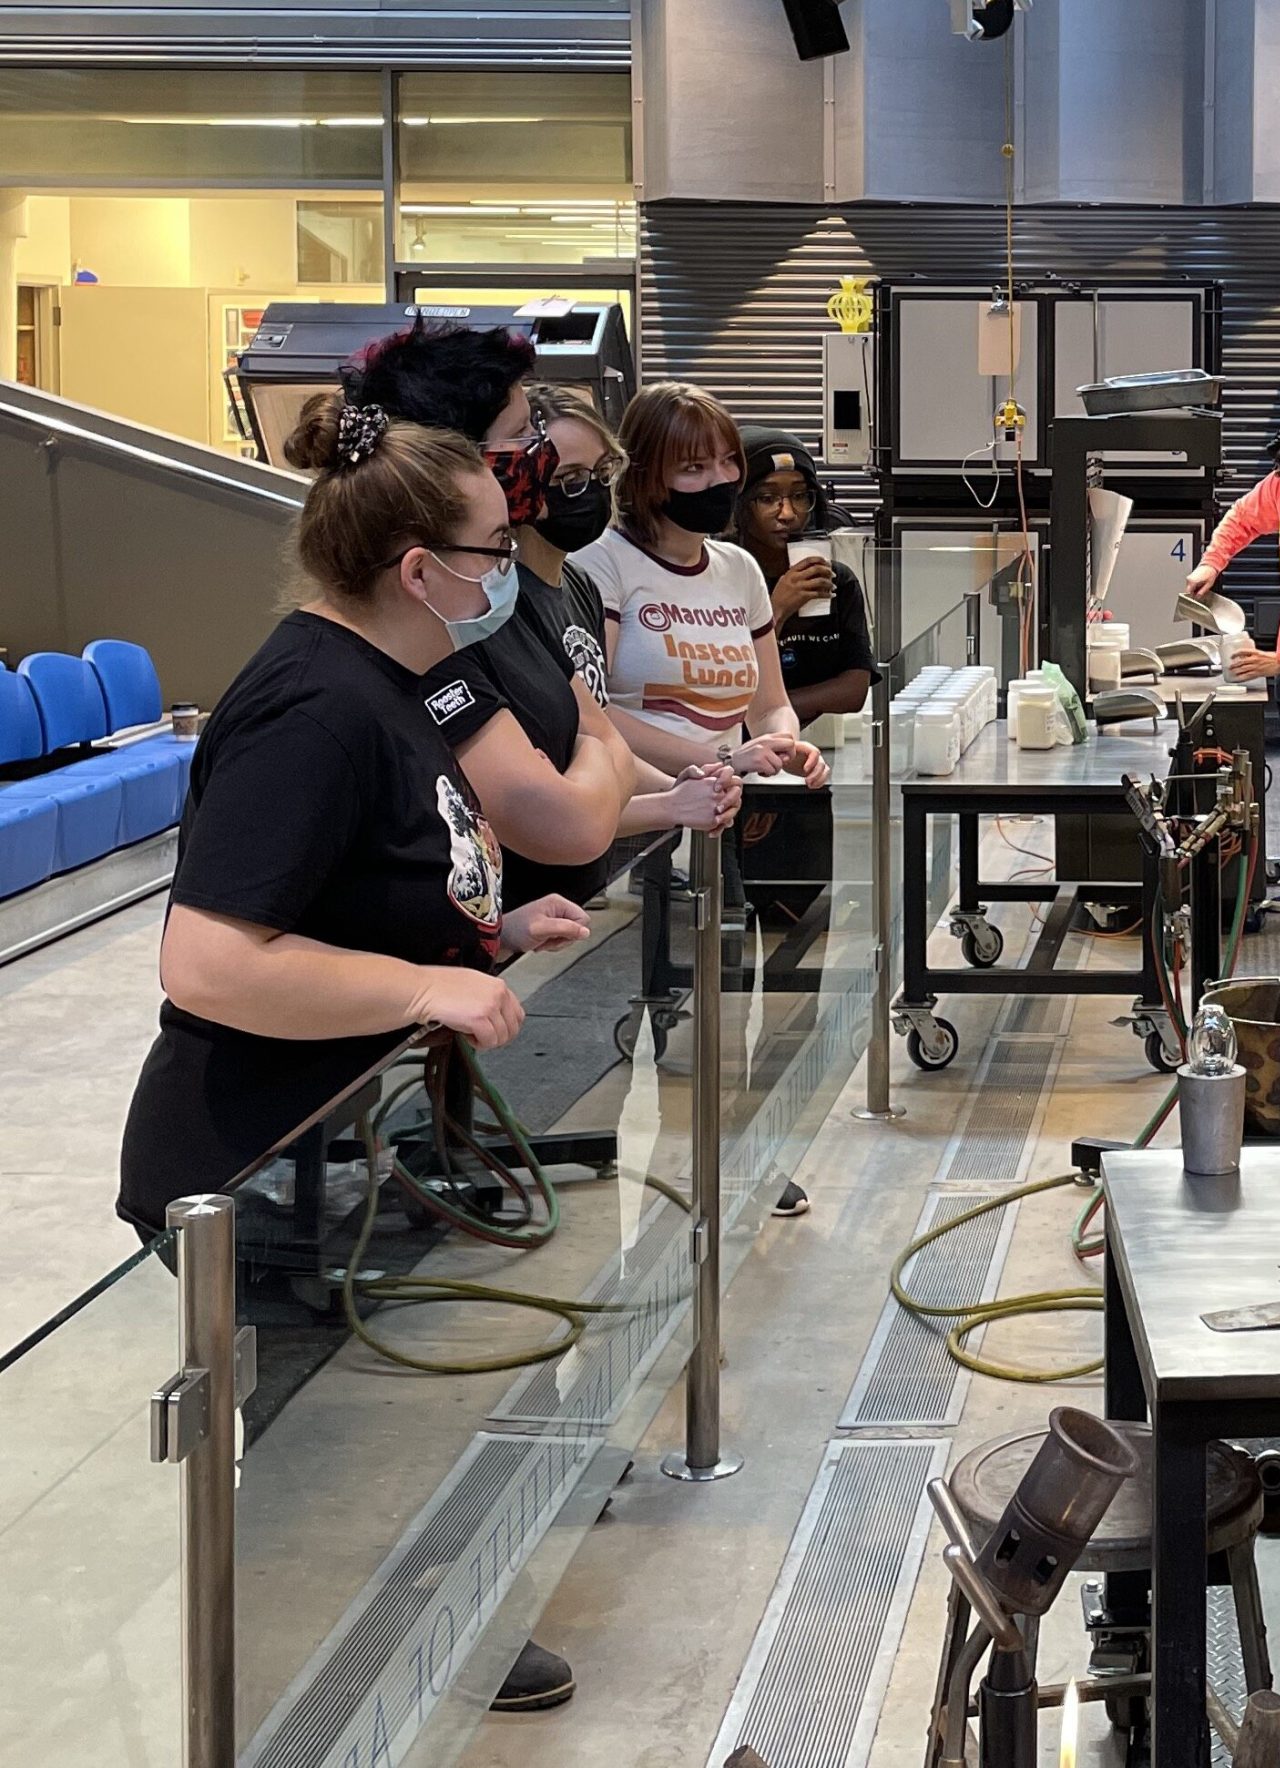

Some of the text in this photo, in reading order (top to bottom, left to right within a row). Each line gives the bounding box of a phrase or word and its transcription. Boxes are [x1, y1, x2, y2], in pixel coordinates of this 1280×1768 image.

[1170, 538, 1187, 562] 4
[663, 633, 755, 665] Instan
[777, 634, 806, 647] ECAUSE
[682, 660, 757, 688] Lunch
[430, 685, 464, 711] Rooster
[441, 695, 466, 715] Teeth
